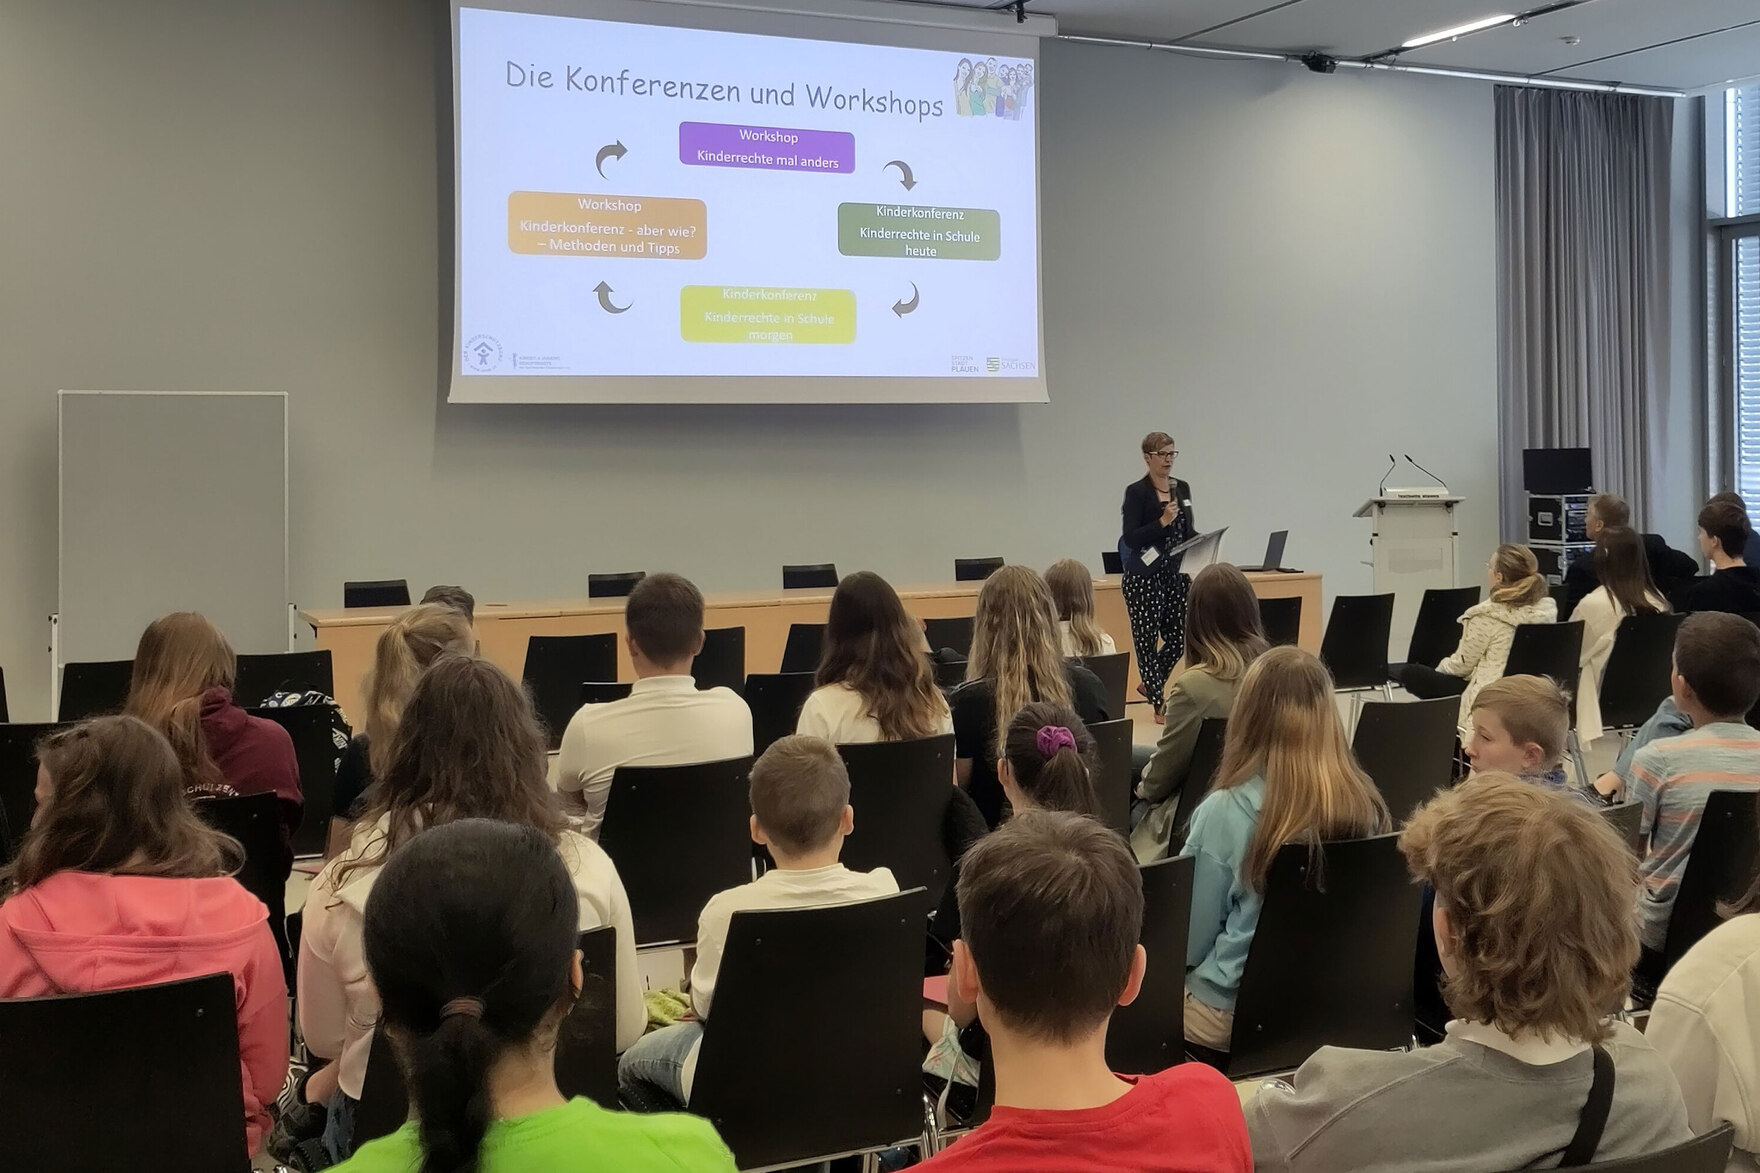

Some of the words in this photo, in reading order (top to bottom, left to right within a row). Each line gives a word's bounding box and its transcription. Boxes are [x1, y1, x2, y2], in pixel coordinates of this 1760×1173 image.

[506, 60, 553, 88] Die
[566, 65, 741, 102] Konferenzen
[750, 82, 795, 106] und
[805, 82, 944, 123] Workshops
[739, 128, 799, 145] Workshop
[697, 150, 773, 165] Kinderrechte
[776, 155, 798, 166] mal
[800, 157, 839, 169] anders
[577, 197, 642, 213] Workshop
[876, 205, 965, 220] Kinderkonferenz
[520, 220, 625, 235] Kinderkonferenz
[636, 225, 664, 237] aber
[668, 225, 697, 238] wie?
[860, 227, 931, 241] Kinderrechte
[933, 230, 943, 241] in
[945, 230, 981, 243] Schule
[549, 238, 617, 253] Methoden
[620, 241, 645, 254] und
[647, 242, 681, 256] Tipps
[905, 245, 937, 257] heute
[722, 288, 817, 302] Kinderkonferenz
[704, 311, 780, 325] Kinderrechte
[784, 314, 795, 324] in
[797, 313, 835, 325] Schule
[748, 331, 793, 343] morgen
[1001, 361, 1036, 370] SACHSEN
